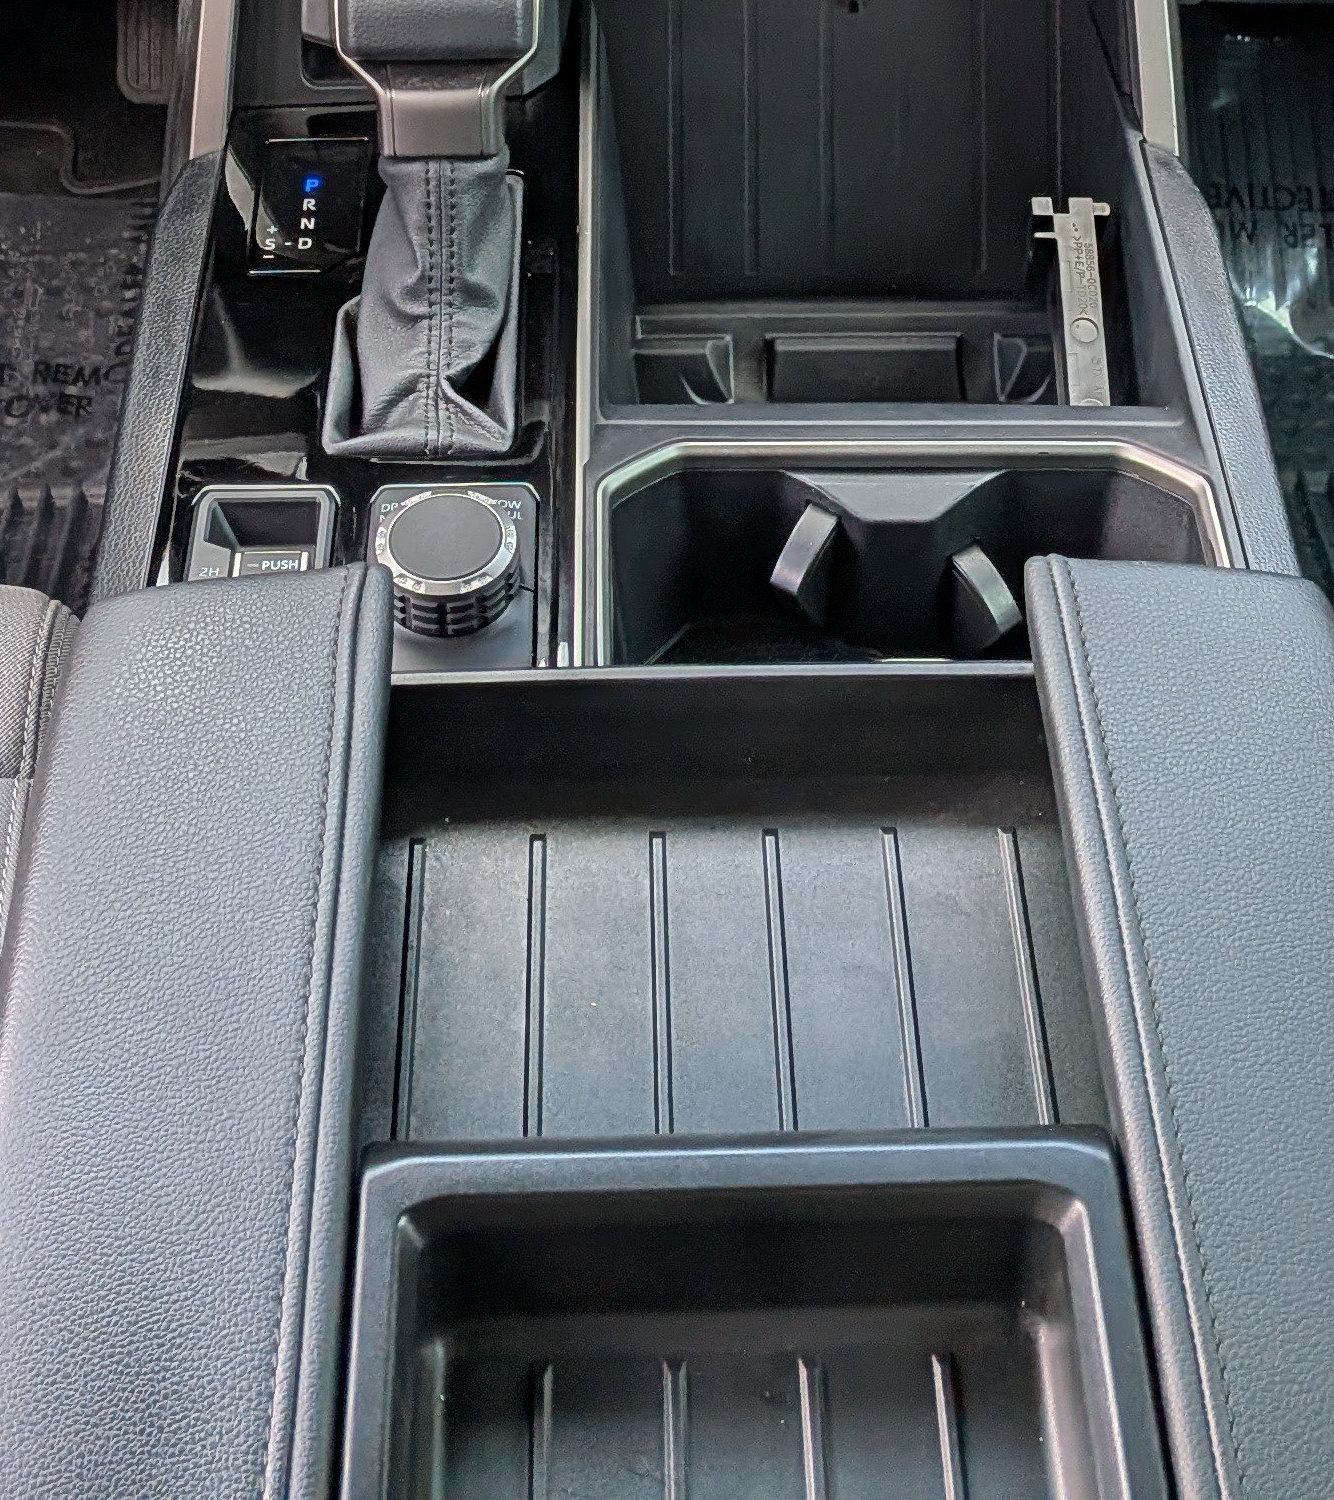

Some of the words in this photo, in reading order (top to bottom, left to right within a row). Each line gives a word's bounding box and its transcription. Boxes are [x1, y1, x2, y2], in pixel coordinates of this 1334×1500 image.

[304, 178, 319, 193] P
[302, 198, 317, 211] R
[300, 217, 316, 230] N
[265, 238, 276, 251] S
[297, 237, 313, 250] D
[33, 360, 130, 390] REMO
[198, 566, 220, 578] 2H
[261, 558, 300, 572] PUSH
